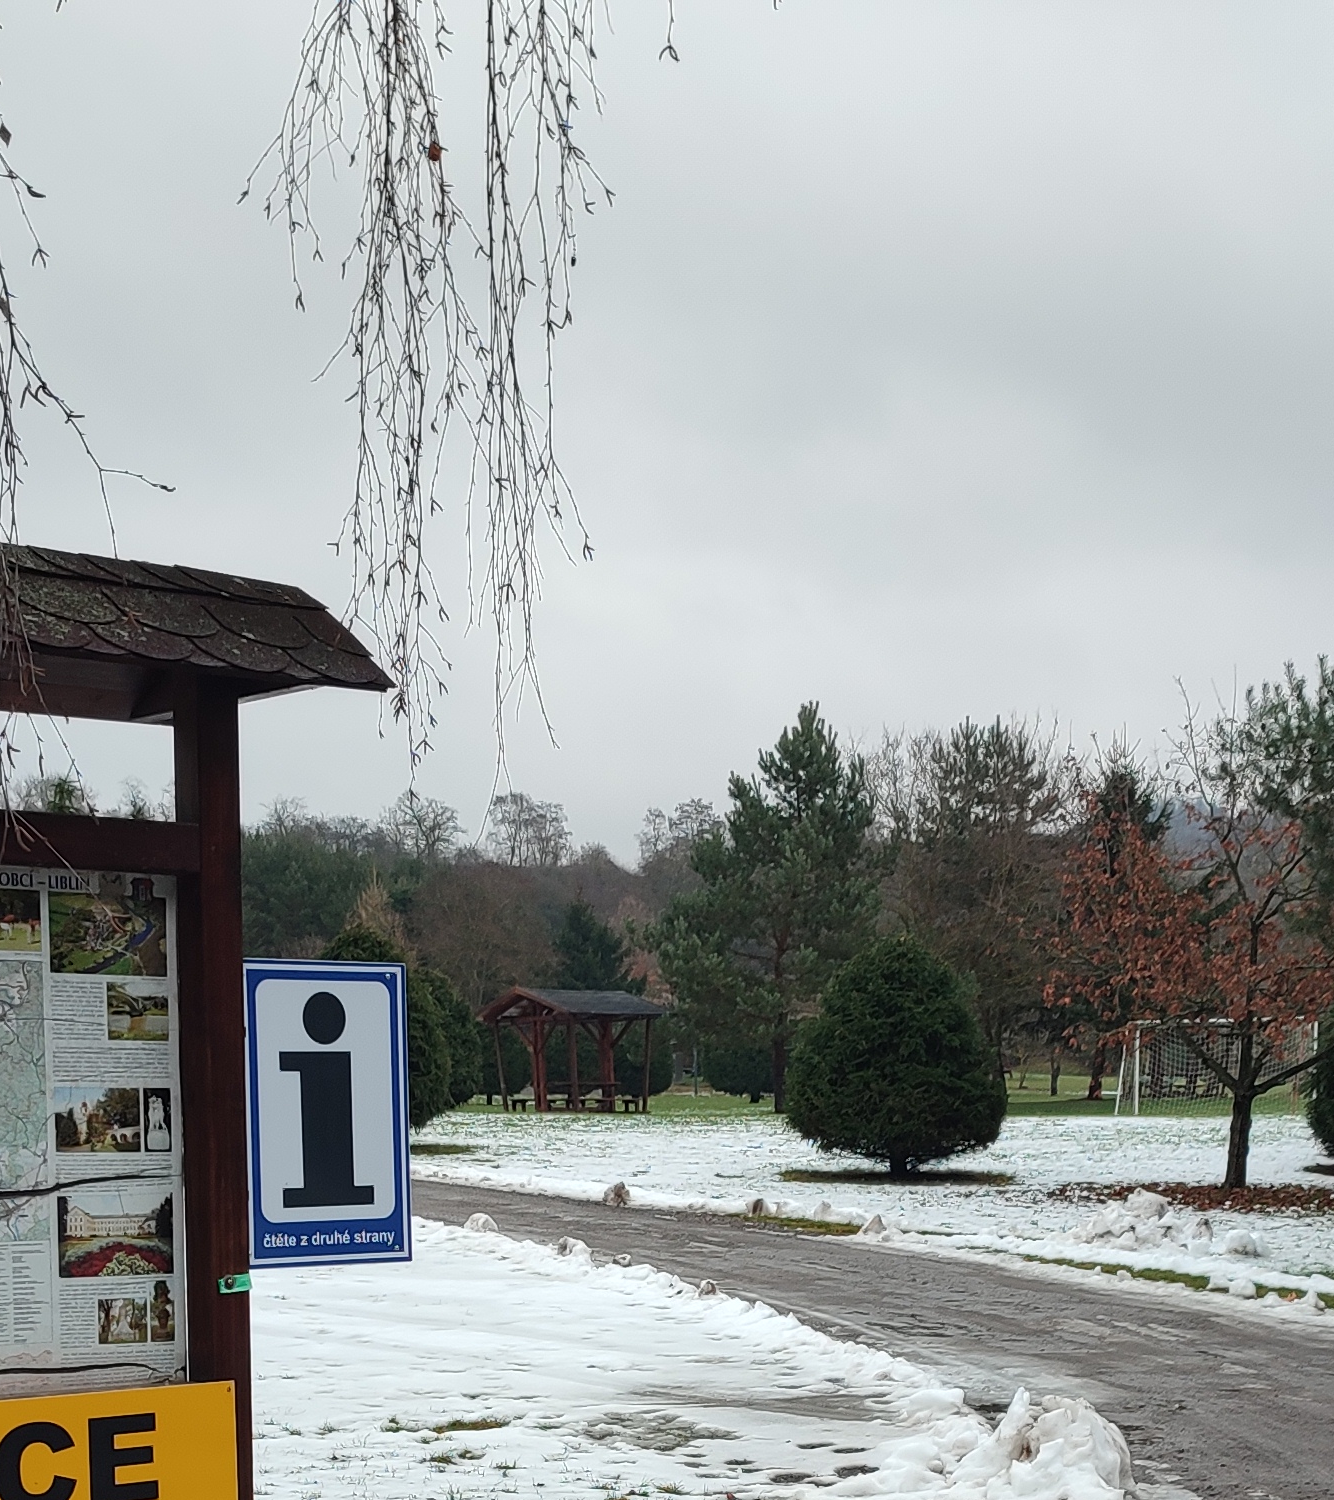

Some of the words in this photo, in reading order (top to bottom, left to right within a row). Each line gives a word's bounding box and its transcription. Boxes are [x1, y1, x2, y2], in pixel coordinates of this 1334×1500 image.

[0, 869, 34, 888] OBCÍ
[264, 1233, 297, 1248] čtěte
[300, 1235, 309, 1246] z
[312, 1230, 351, 1246] druhé
[353, 1230, 395, 1246] strany
